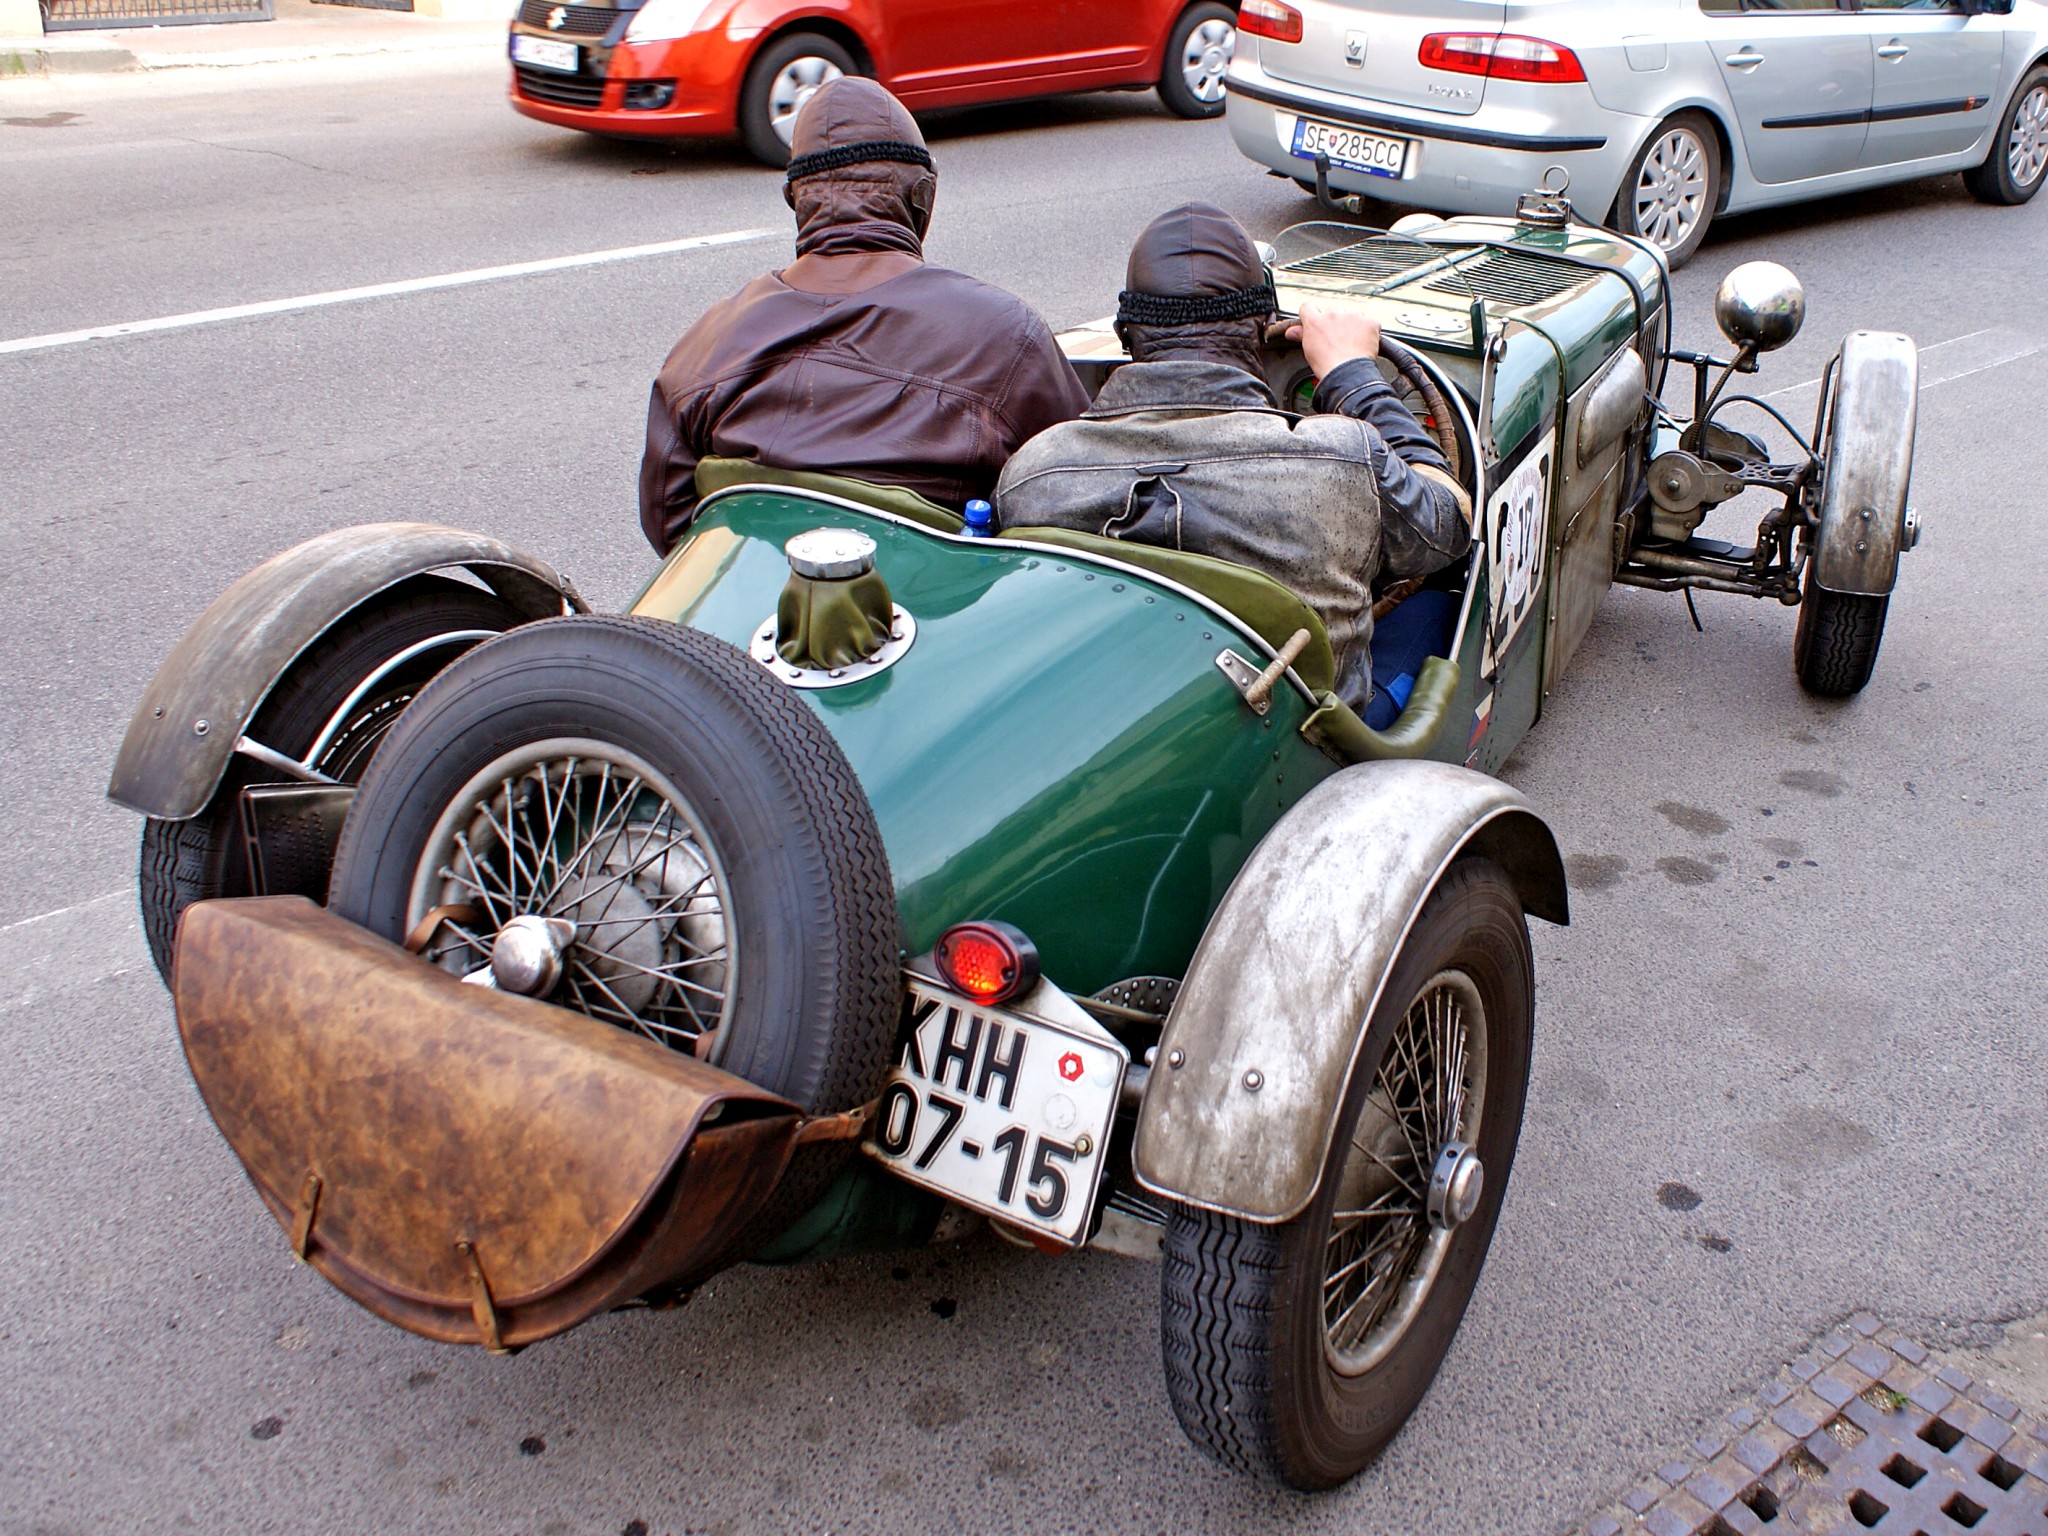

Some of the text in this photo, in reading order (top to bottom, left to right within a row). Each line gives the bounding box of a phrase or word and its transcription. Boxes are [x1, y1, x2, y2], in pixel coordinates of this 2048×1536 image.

[1336, 132, 1400, 167] 285CC
[899, 989, 1030, 1110] KHH
[877, 1081, 1077, 1218] 07-15
